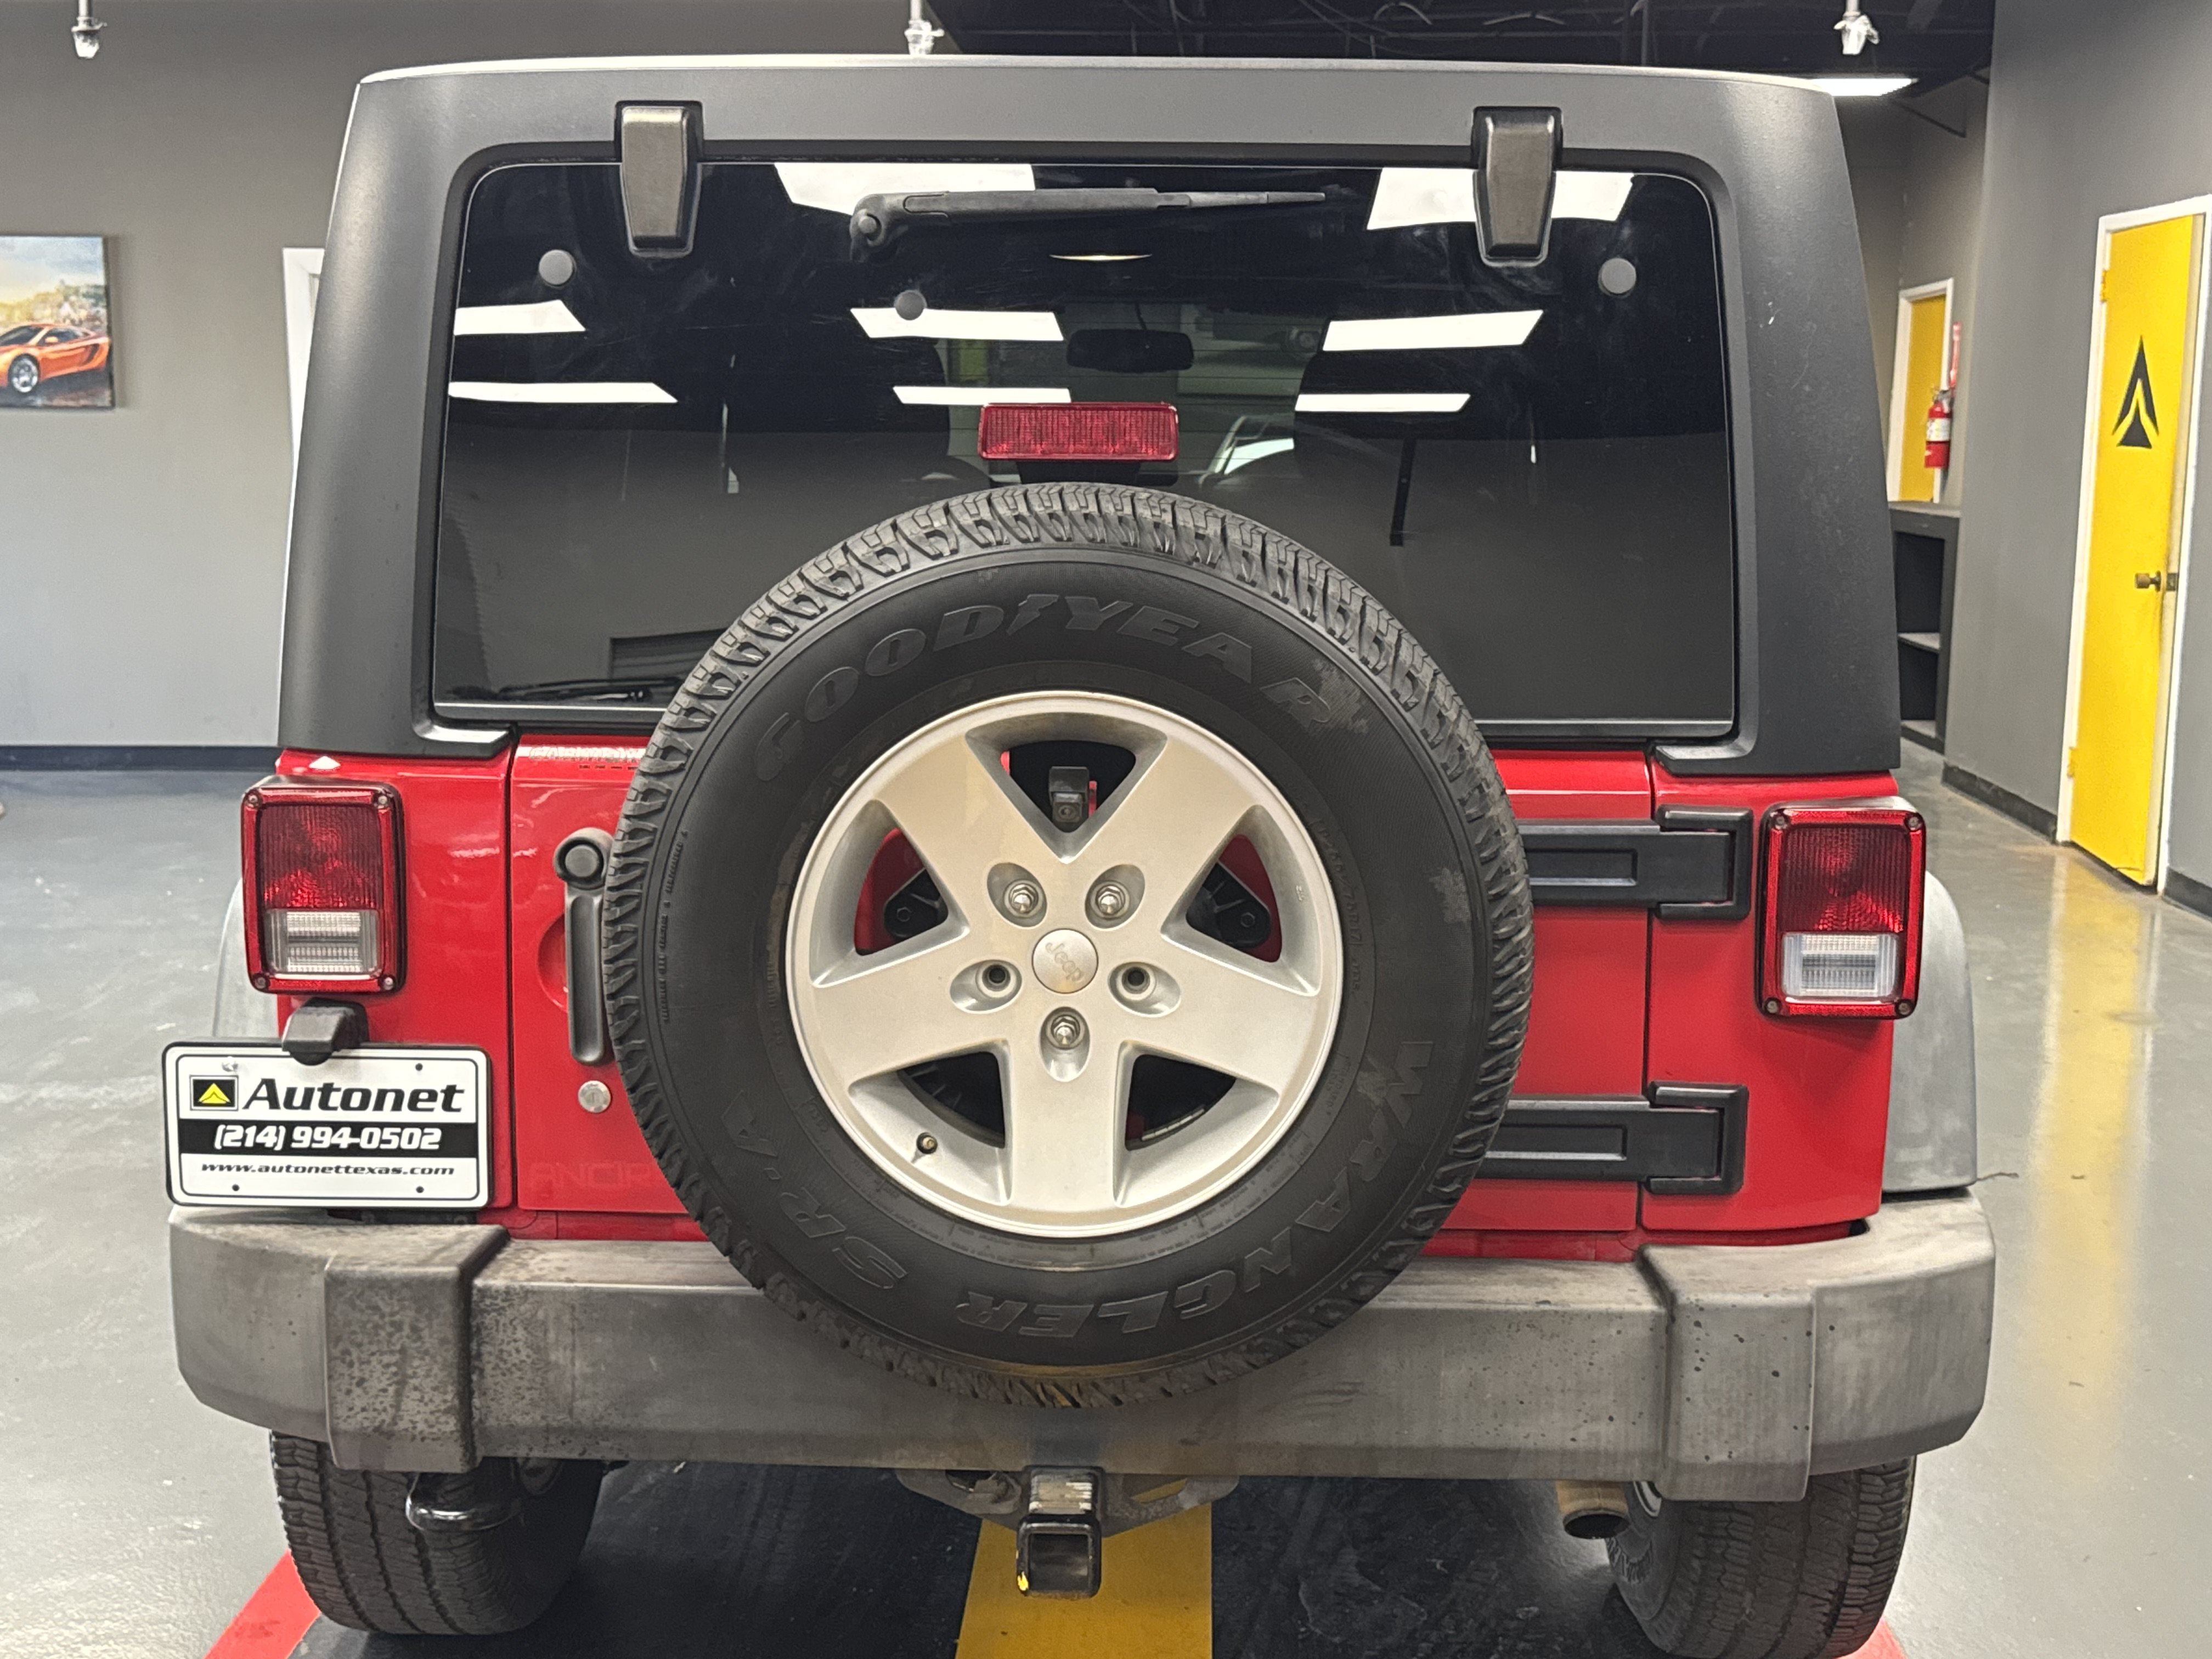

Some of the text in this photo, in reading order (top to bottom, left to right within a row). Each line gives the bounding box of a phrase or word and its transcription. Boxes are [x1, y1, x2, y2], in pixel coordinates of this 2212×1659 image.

[755, 594, 1334, 781] GOODYEAR
[242, 1078, 465, 1113] Autonet
[214, 1125, 442, 1150] (214) 994-0502
[201, 1163, 455, 1175] www.autonettexas.com
[955, 1041, 1432, 1337] WRANGLER
